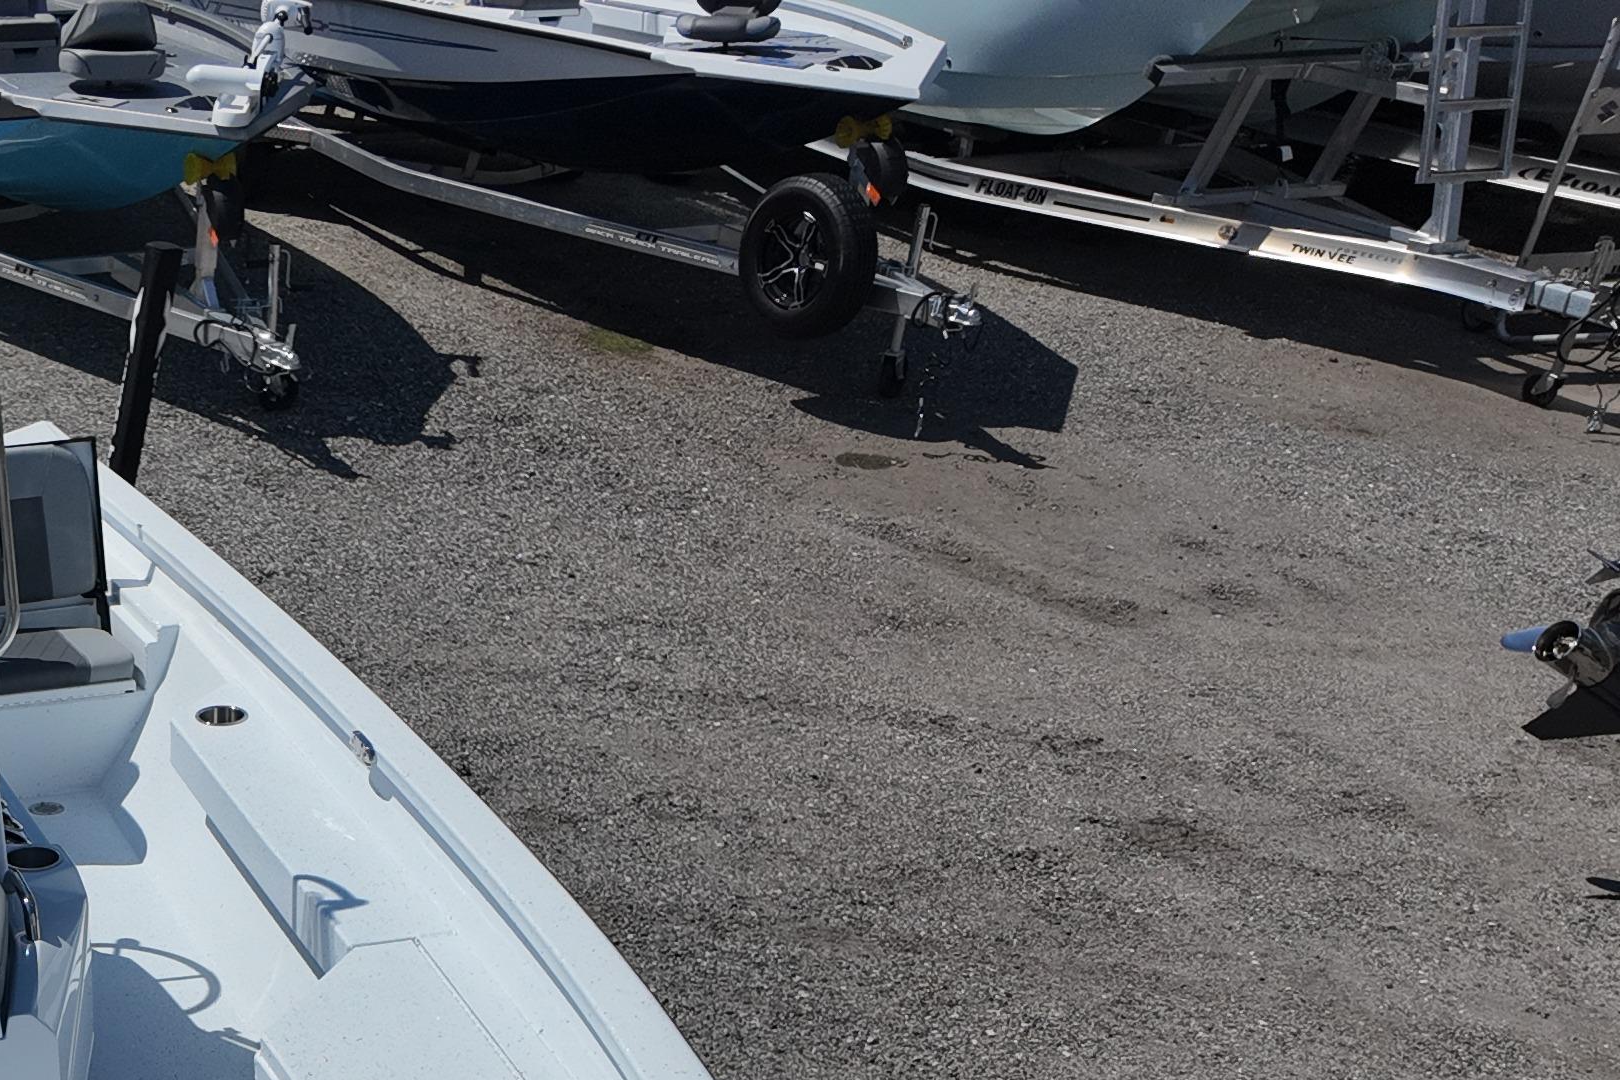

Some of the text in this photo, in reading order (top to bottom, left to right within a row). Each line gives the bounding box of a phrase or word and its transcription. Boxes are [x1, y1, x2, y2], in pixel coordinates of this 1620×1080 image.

[975, 178, 1049, 205] FLOAT-ON
[1292, 243, 1357, 265] TWIN VEE
